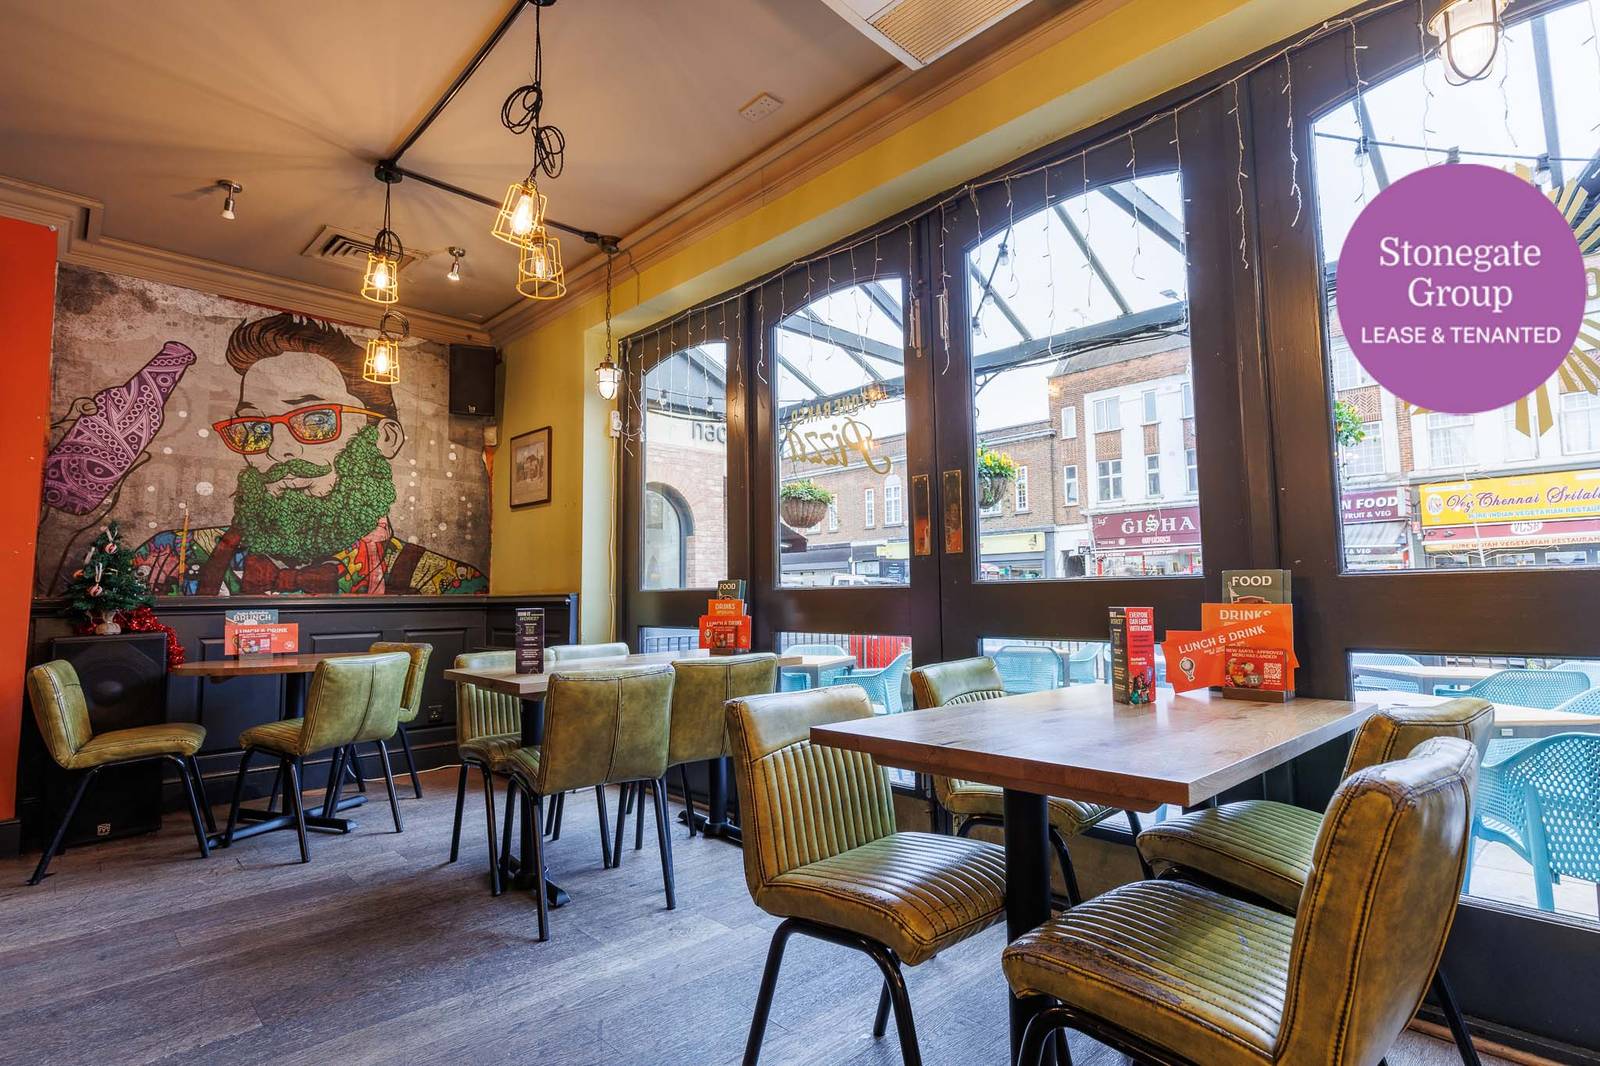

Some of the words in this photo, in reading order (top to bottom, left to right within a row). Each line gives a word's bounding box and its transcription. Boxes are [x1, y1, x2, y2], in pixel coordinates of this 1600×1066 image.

[1356, 496, 1398, 509] FOOD
[1476, 491, 1540, 508] Chennai
[1546, 485, 1600, 506] Srilal
[1489, 511, 1514, 519] INDIAN
[1515, 507, 1563, 517] VEGETARIAN
[1500, 538, 1550, 547] VEGETARIAN
[1232, 575, 1272, 587] FOOD
[1178, 637, 1217, 654] LUNCH
[1218, 634, 1226, 644] &
[1228, 625, 1266, 642] DRINK
